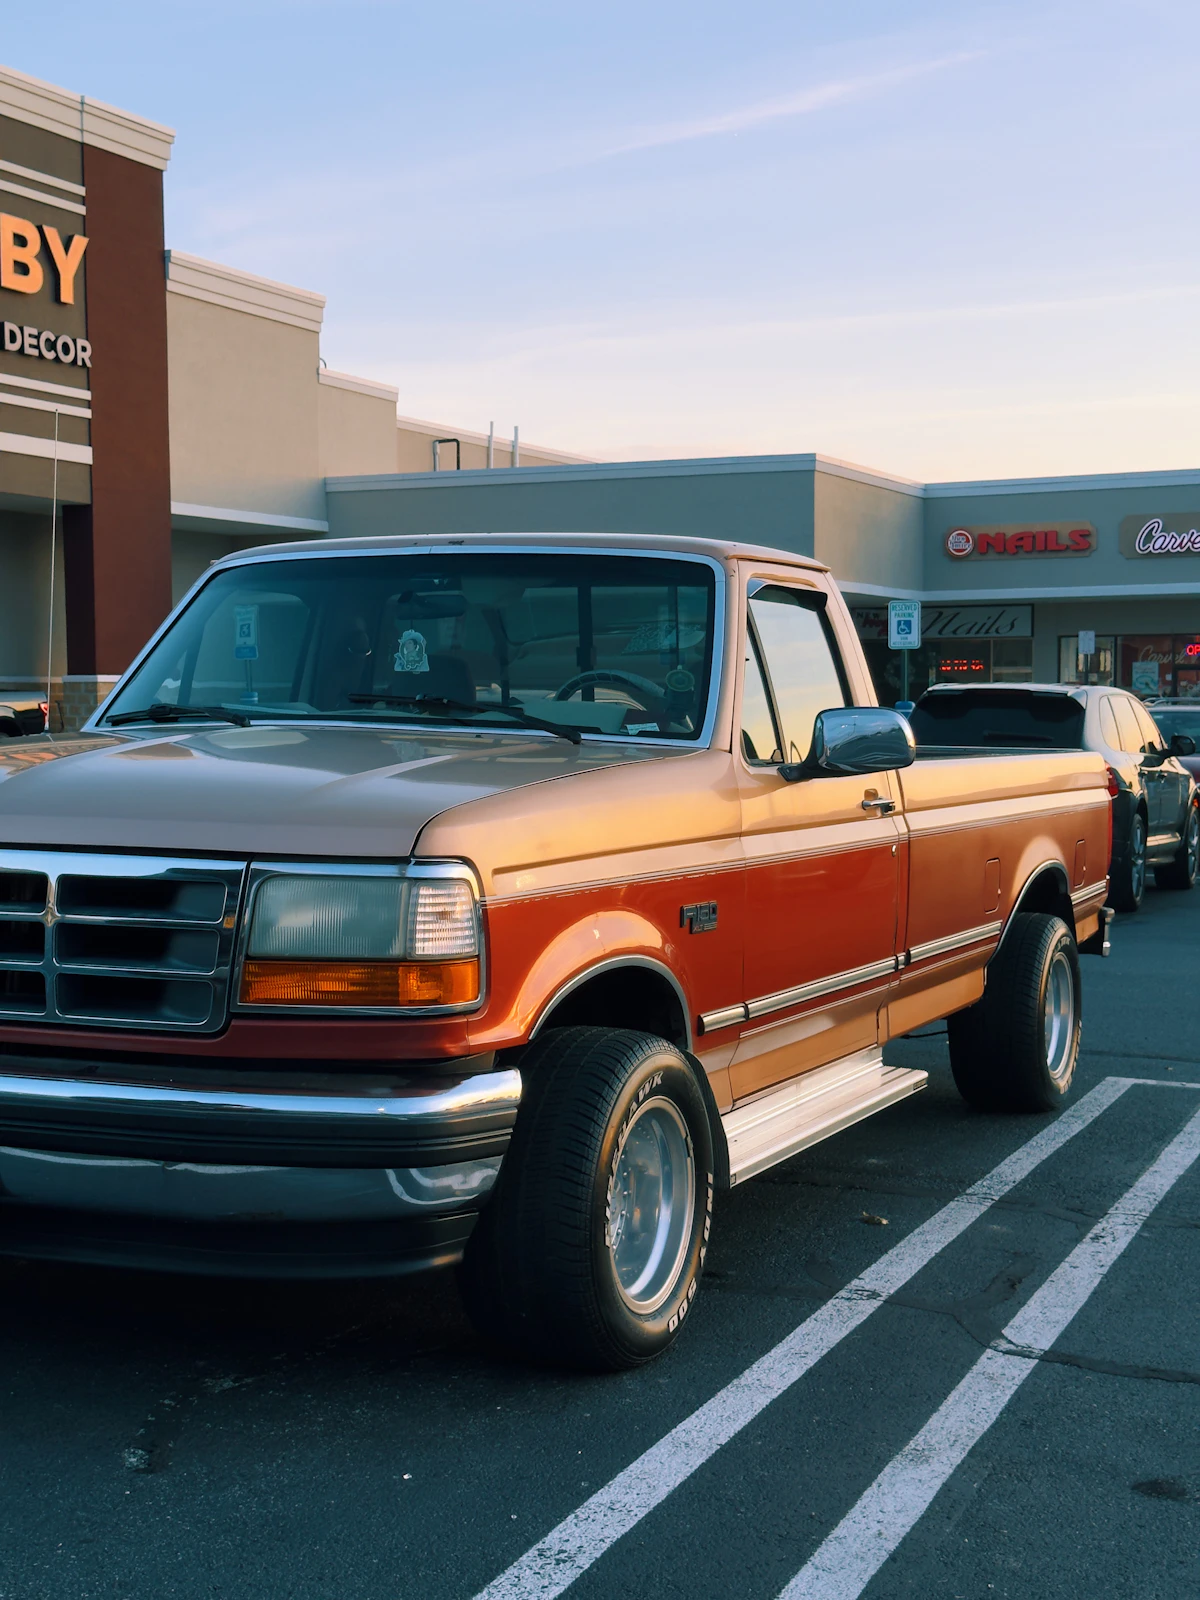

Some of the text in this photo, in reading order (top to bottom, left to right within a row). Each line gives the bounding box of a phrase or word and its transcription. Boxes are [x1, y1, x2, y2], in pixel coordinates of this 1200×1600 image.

[0, 212, 89, 305] BY
[3, 321, 92, 368] DECOR
[977, 530, 1090, 554] NAILS
[921, 609, 1020, 636] Nails
